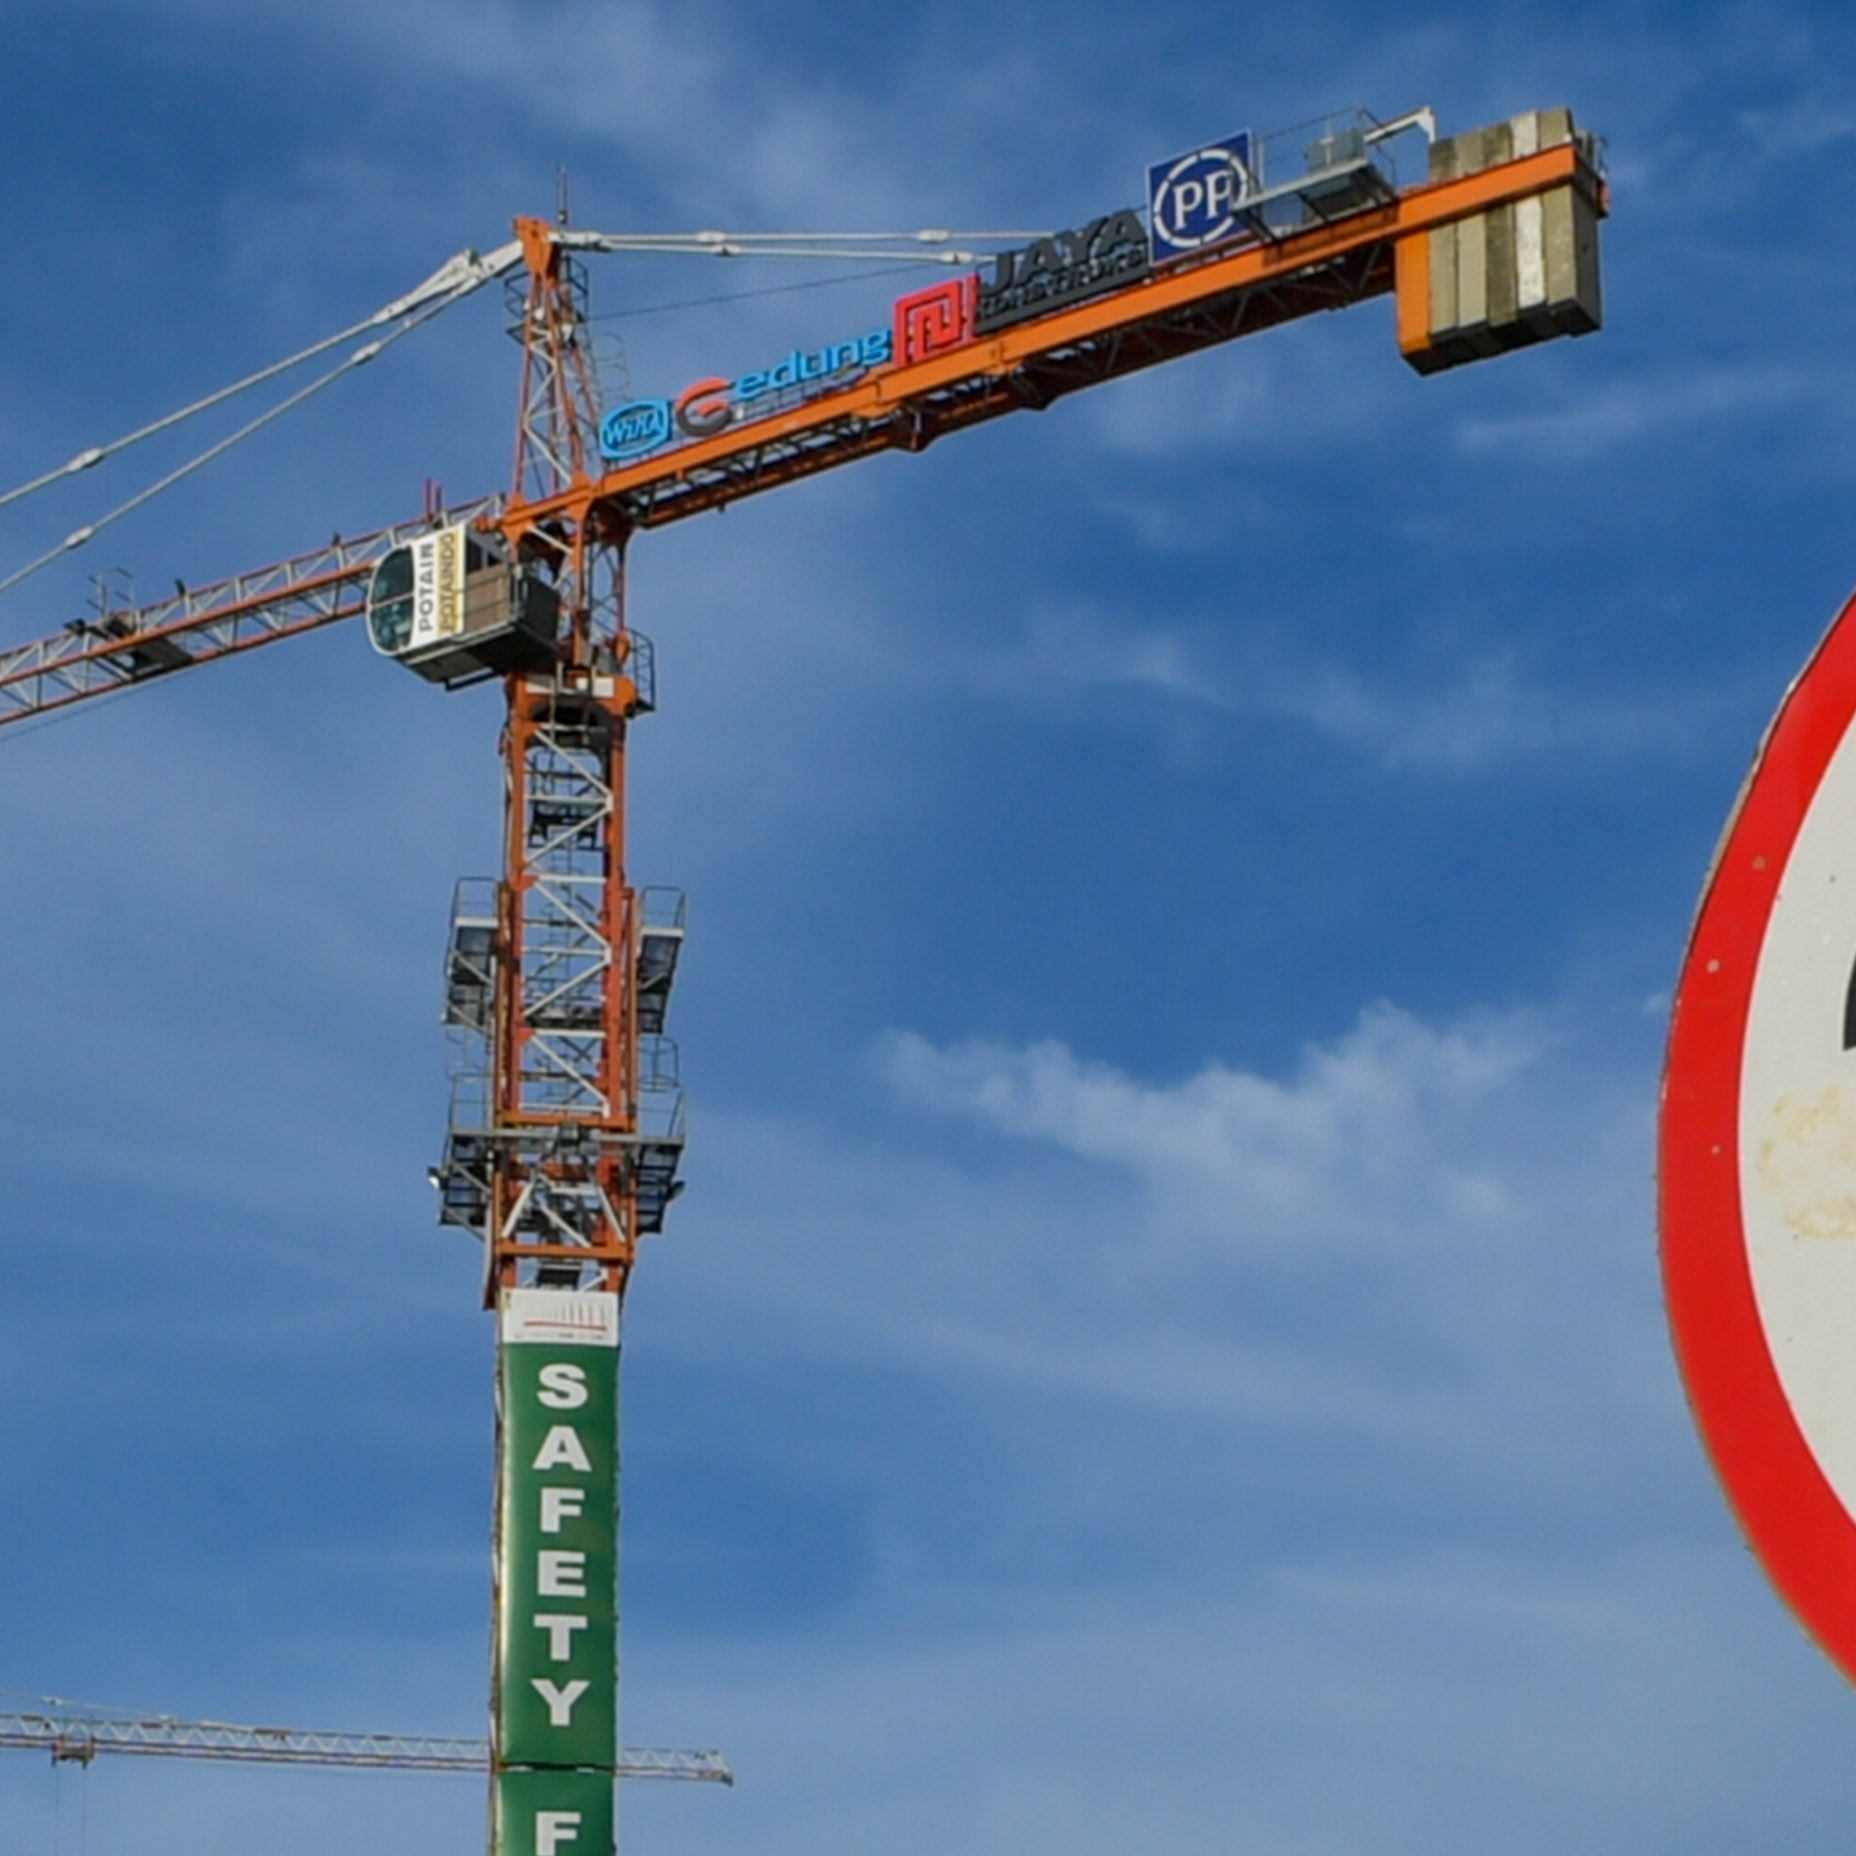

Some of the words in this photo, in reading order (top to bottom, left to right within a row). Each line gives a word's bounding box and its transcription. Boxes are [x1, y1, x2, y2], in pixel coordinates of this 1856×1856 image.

[1173, 169, 1232, 230] PP
[980, 208, 1148, 294] JAYA
[675, 326, 893, 437] Gedung
[418, 542, 435, 632] POTAIN
[530, 1363, 592, 1727] SAFETY
